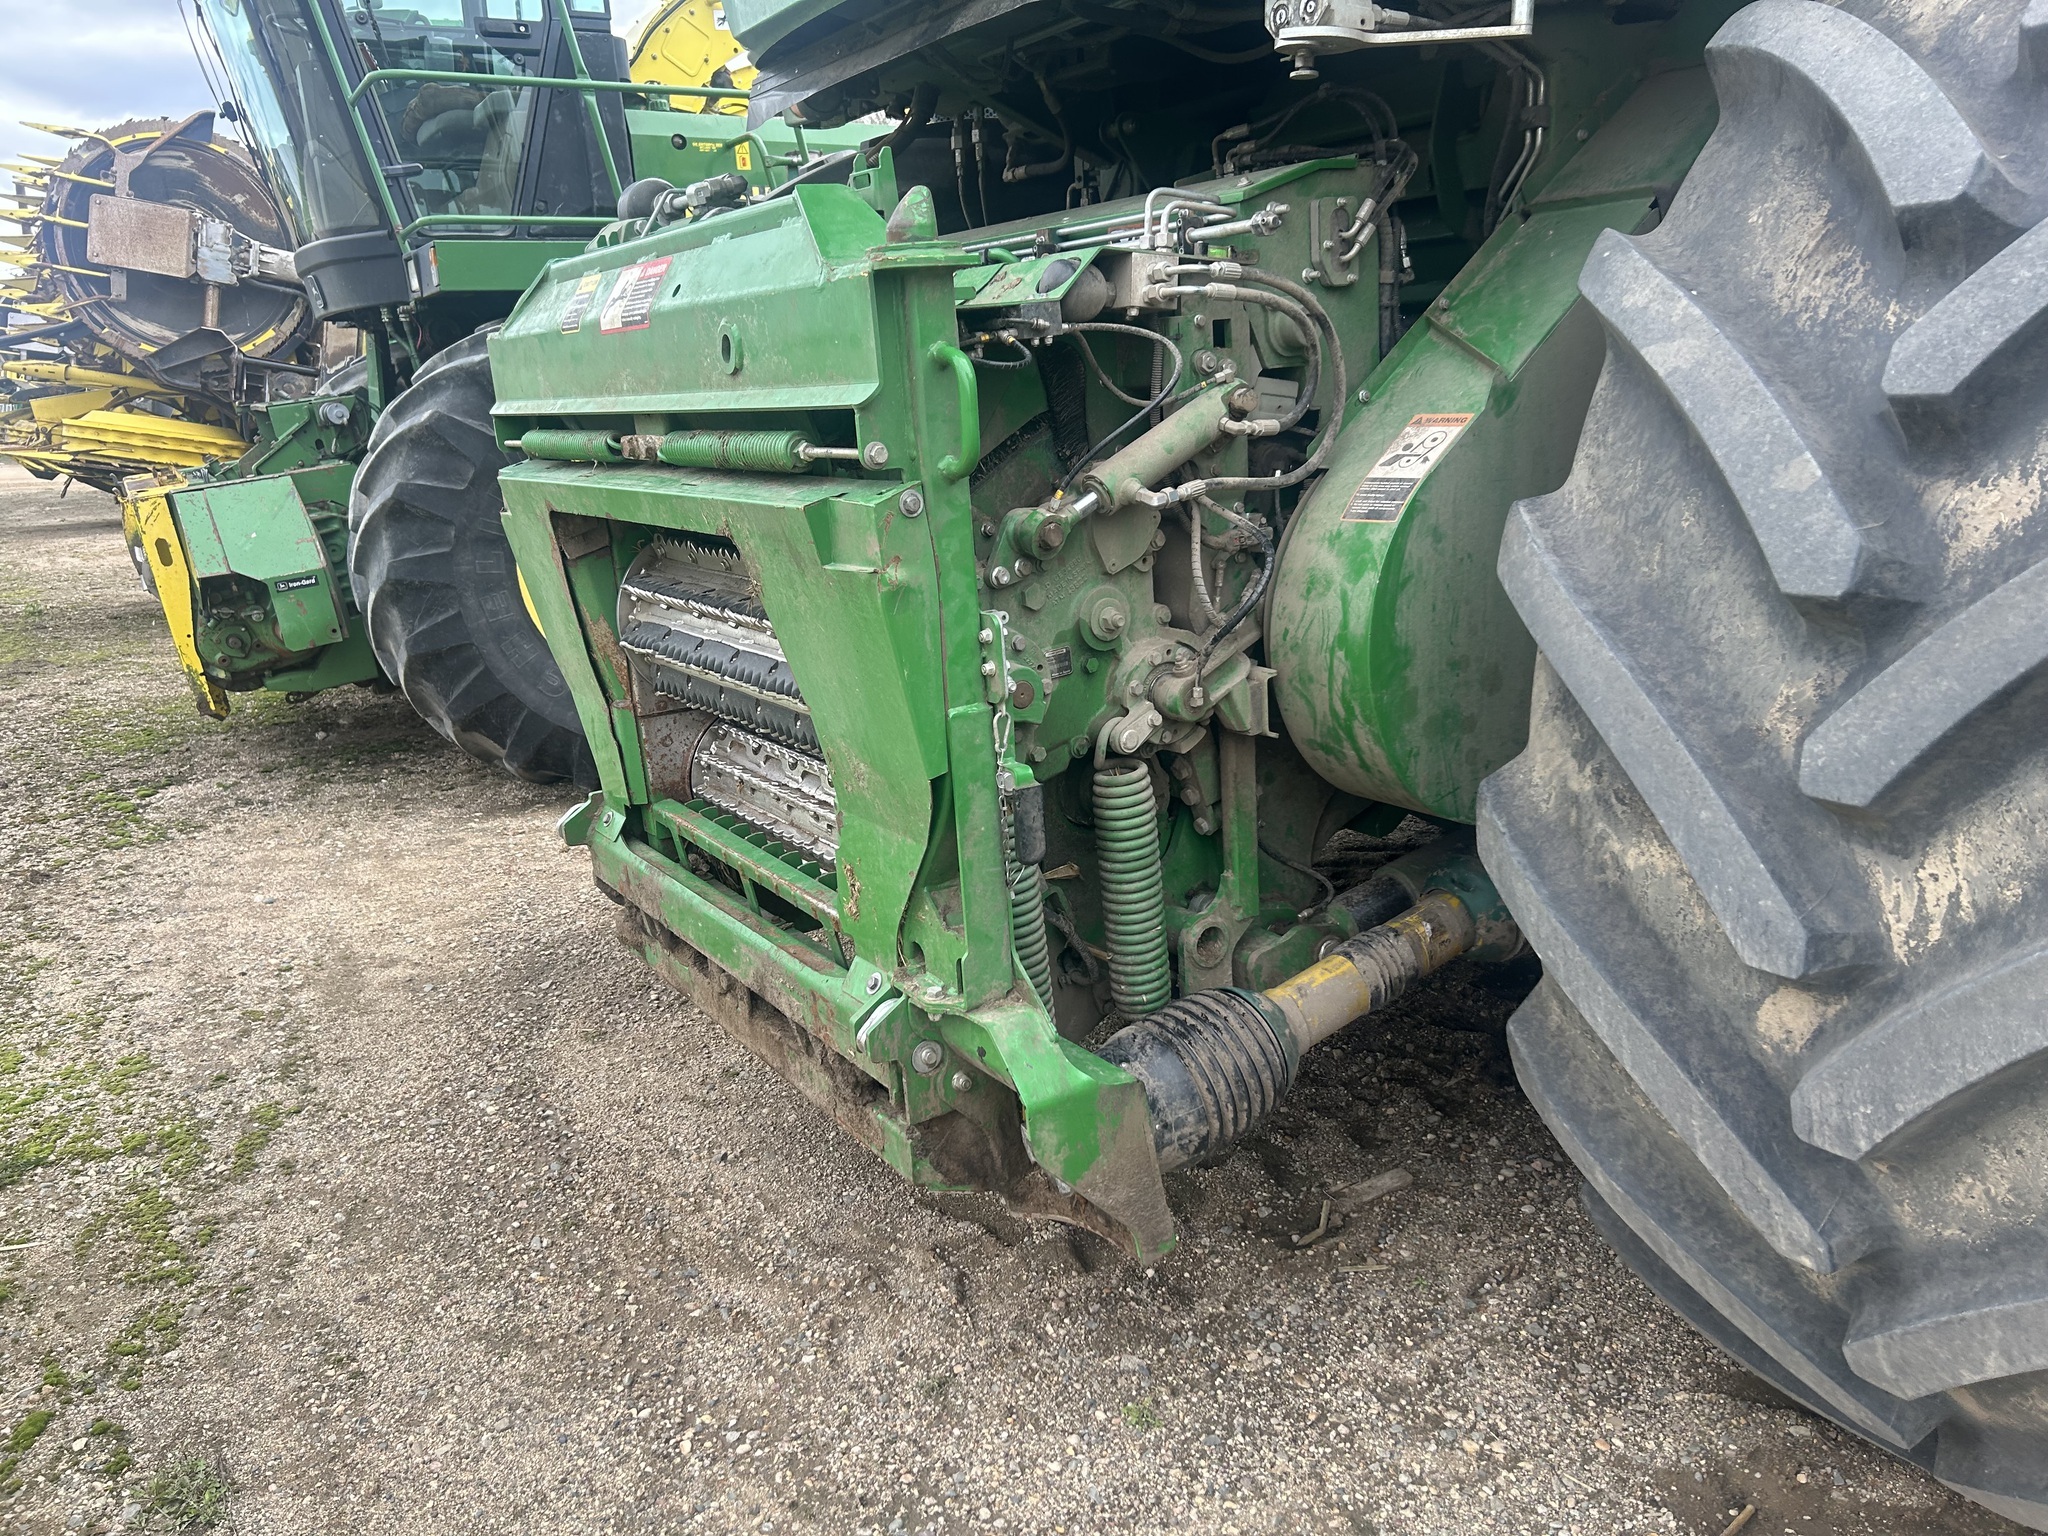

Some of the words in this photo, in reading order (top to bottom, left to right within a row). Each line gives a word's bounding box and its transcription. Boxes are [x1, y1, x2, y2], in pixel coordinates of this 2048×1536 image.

[644, 263, 668, 277] DANGER
[1425, 416, 1468, 424] WARNING
[288, 576, 316, 588] Iron-Gard
